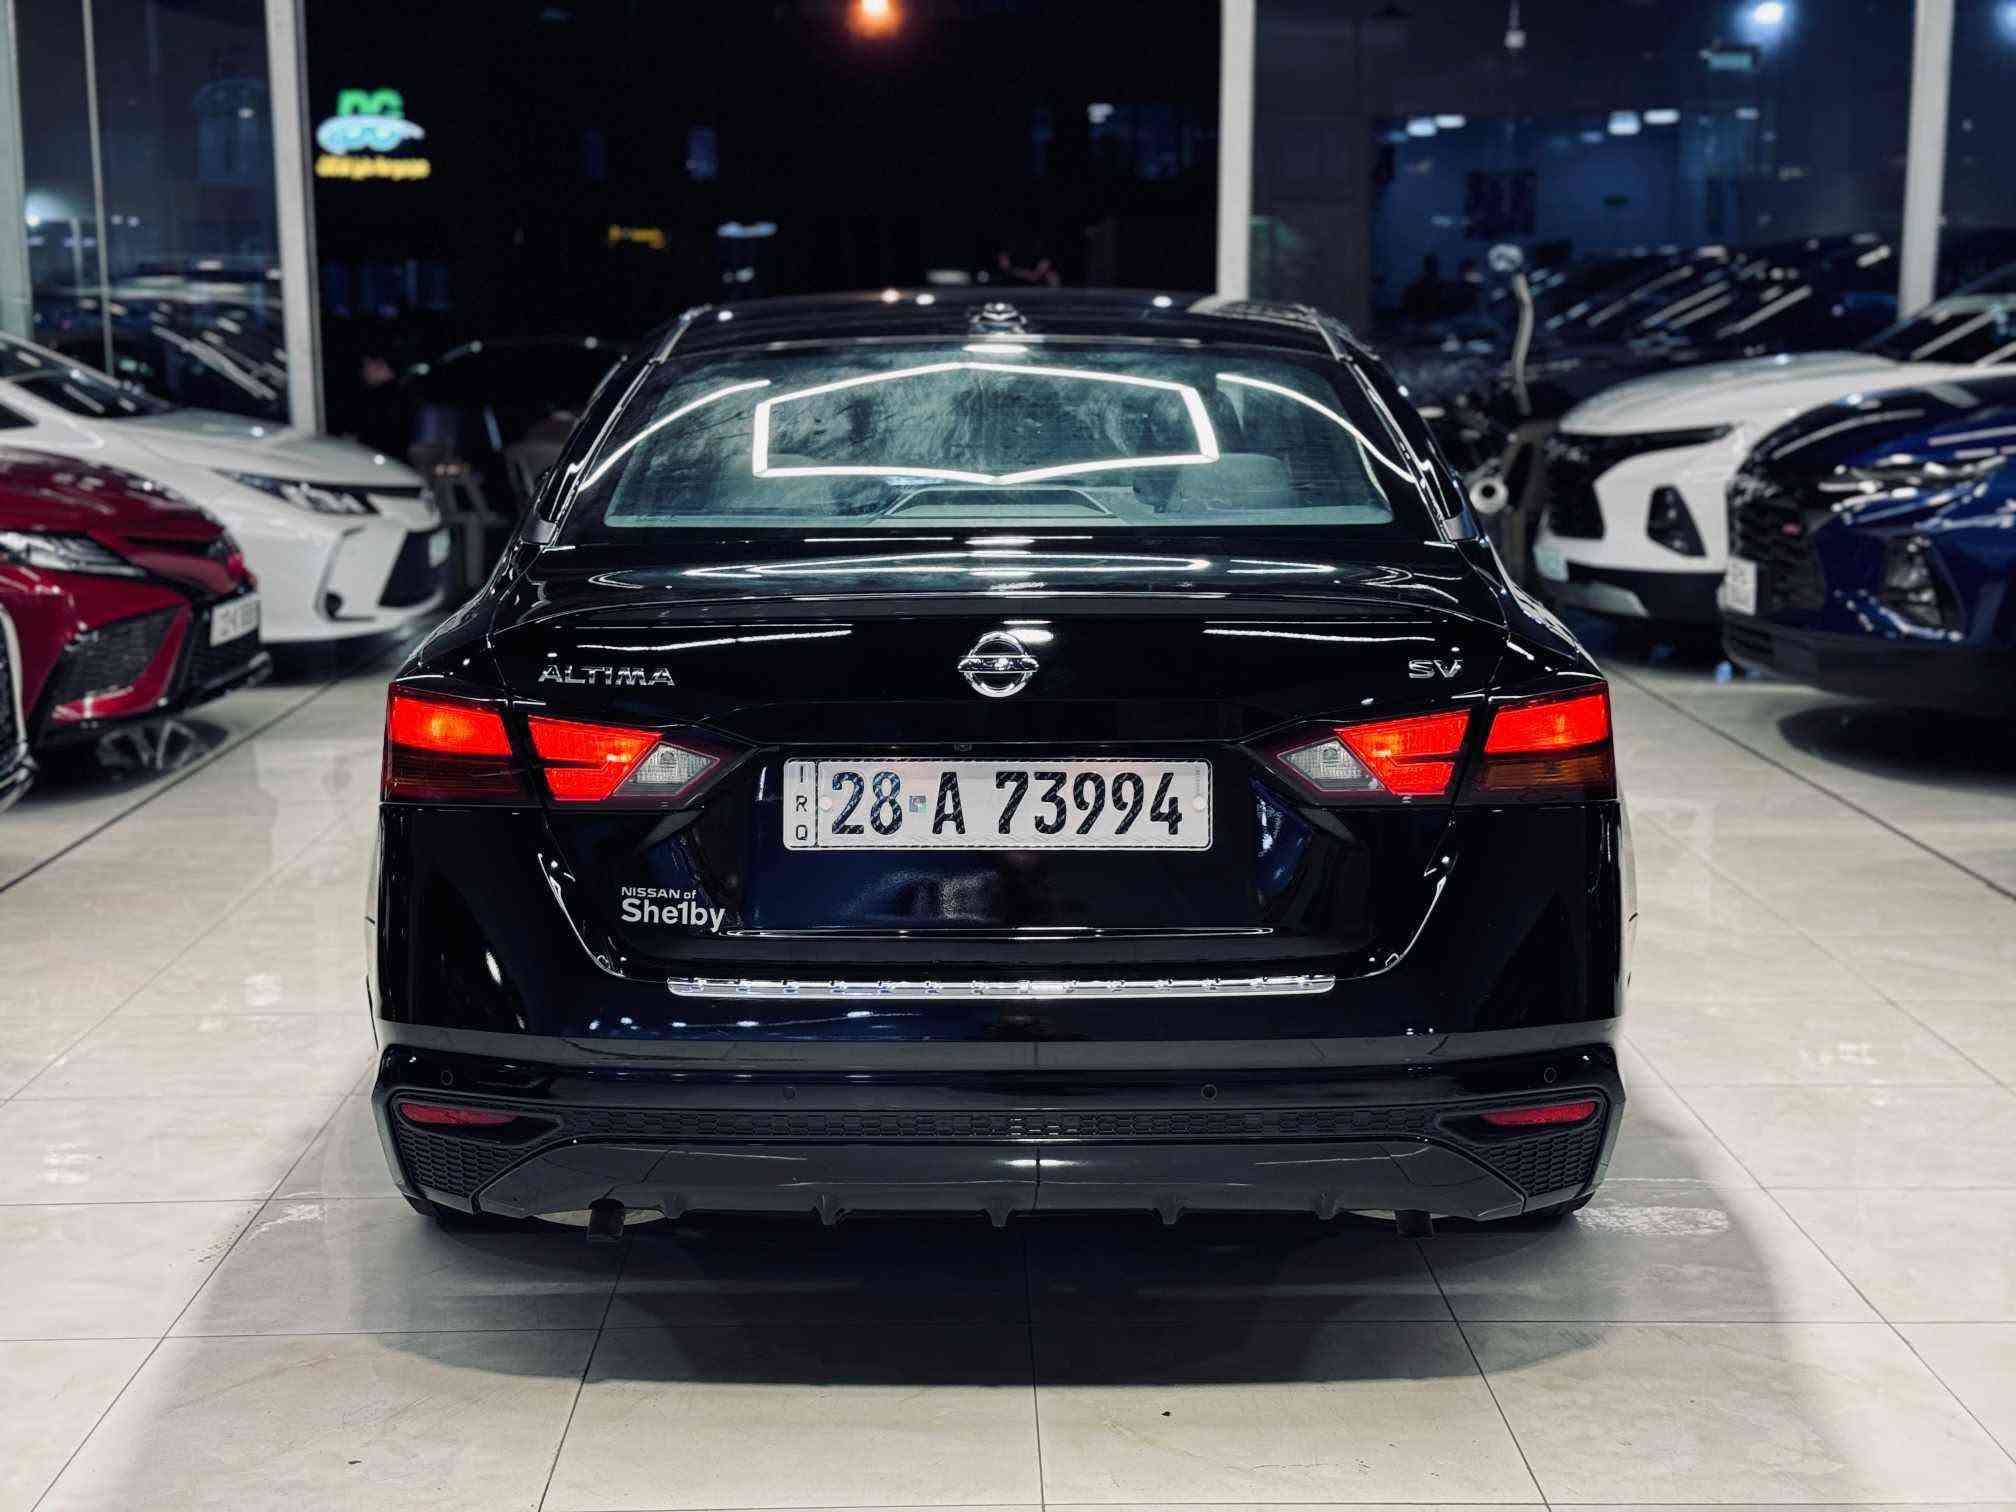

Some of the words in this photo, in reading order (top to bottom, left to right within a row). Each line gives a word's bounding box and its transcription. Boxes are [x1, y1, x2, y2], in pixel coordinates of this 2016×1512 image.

[538, 664, 675, 686] ALTIMA
[1408, 659, 1463, 679] SV
[831, 771, 904, 836] 28
[932, 771, 966, 836] A
[995, 771, 1183, 836] 73994
[621, 886, 681, 899] NISSAN
[683, 889, 697, 900] of
